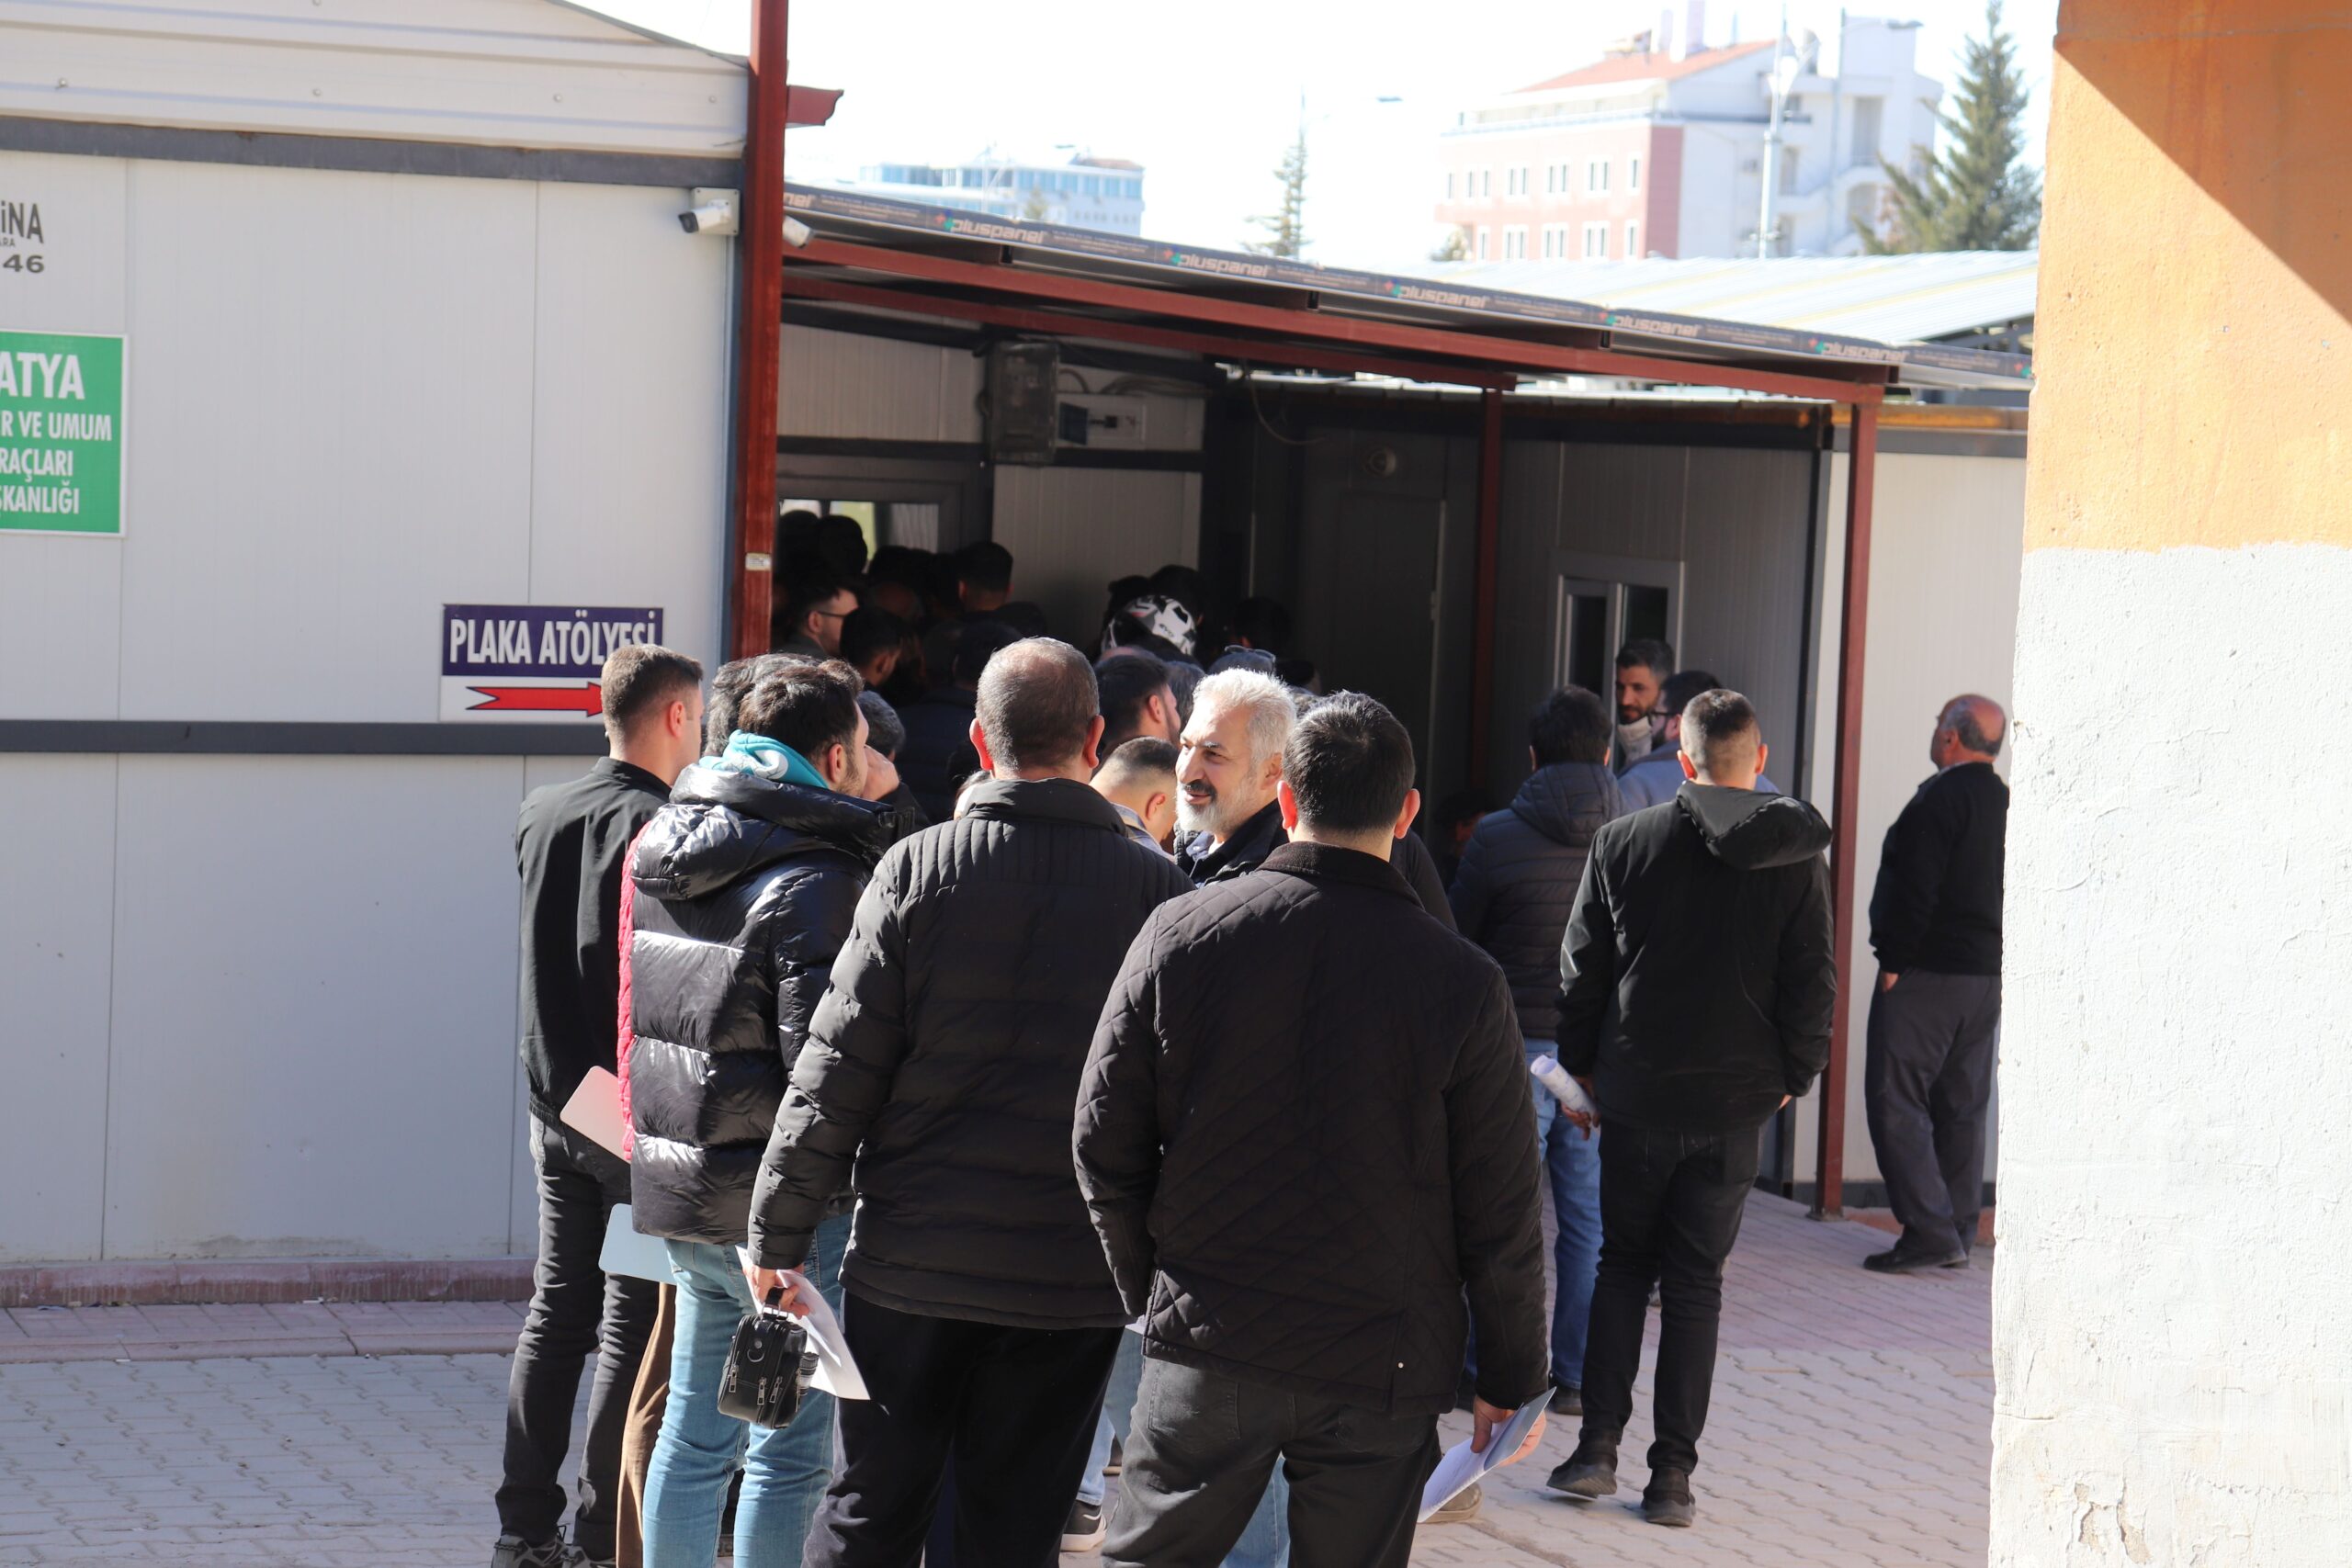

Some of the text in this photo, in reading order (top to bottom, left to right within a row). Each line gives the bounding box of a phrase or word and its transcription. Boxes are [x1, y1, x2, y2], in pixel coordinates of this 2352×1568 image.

[950, 219, 1046, 244] pluspanel
[3, 254, 45, 274] 46
[1177, 253, 1268, 278] pluspanel
[0, 351, 85, 400] ATYA
[18, 411, 42, 439] VE
[48, 412, 112, 442] UMUM
[449, 618, 533, 665] PLAKA
